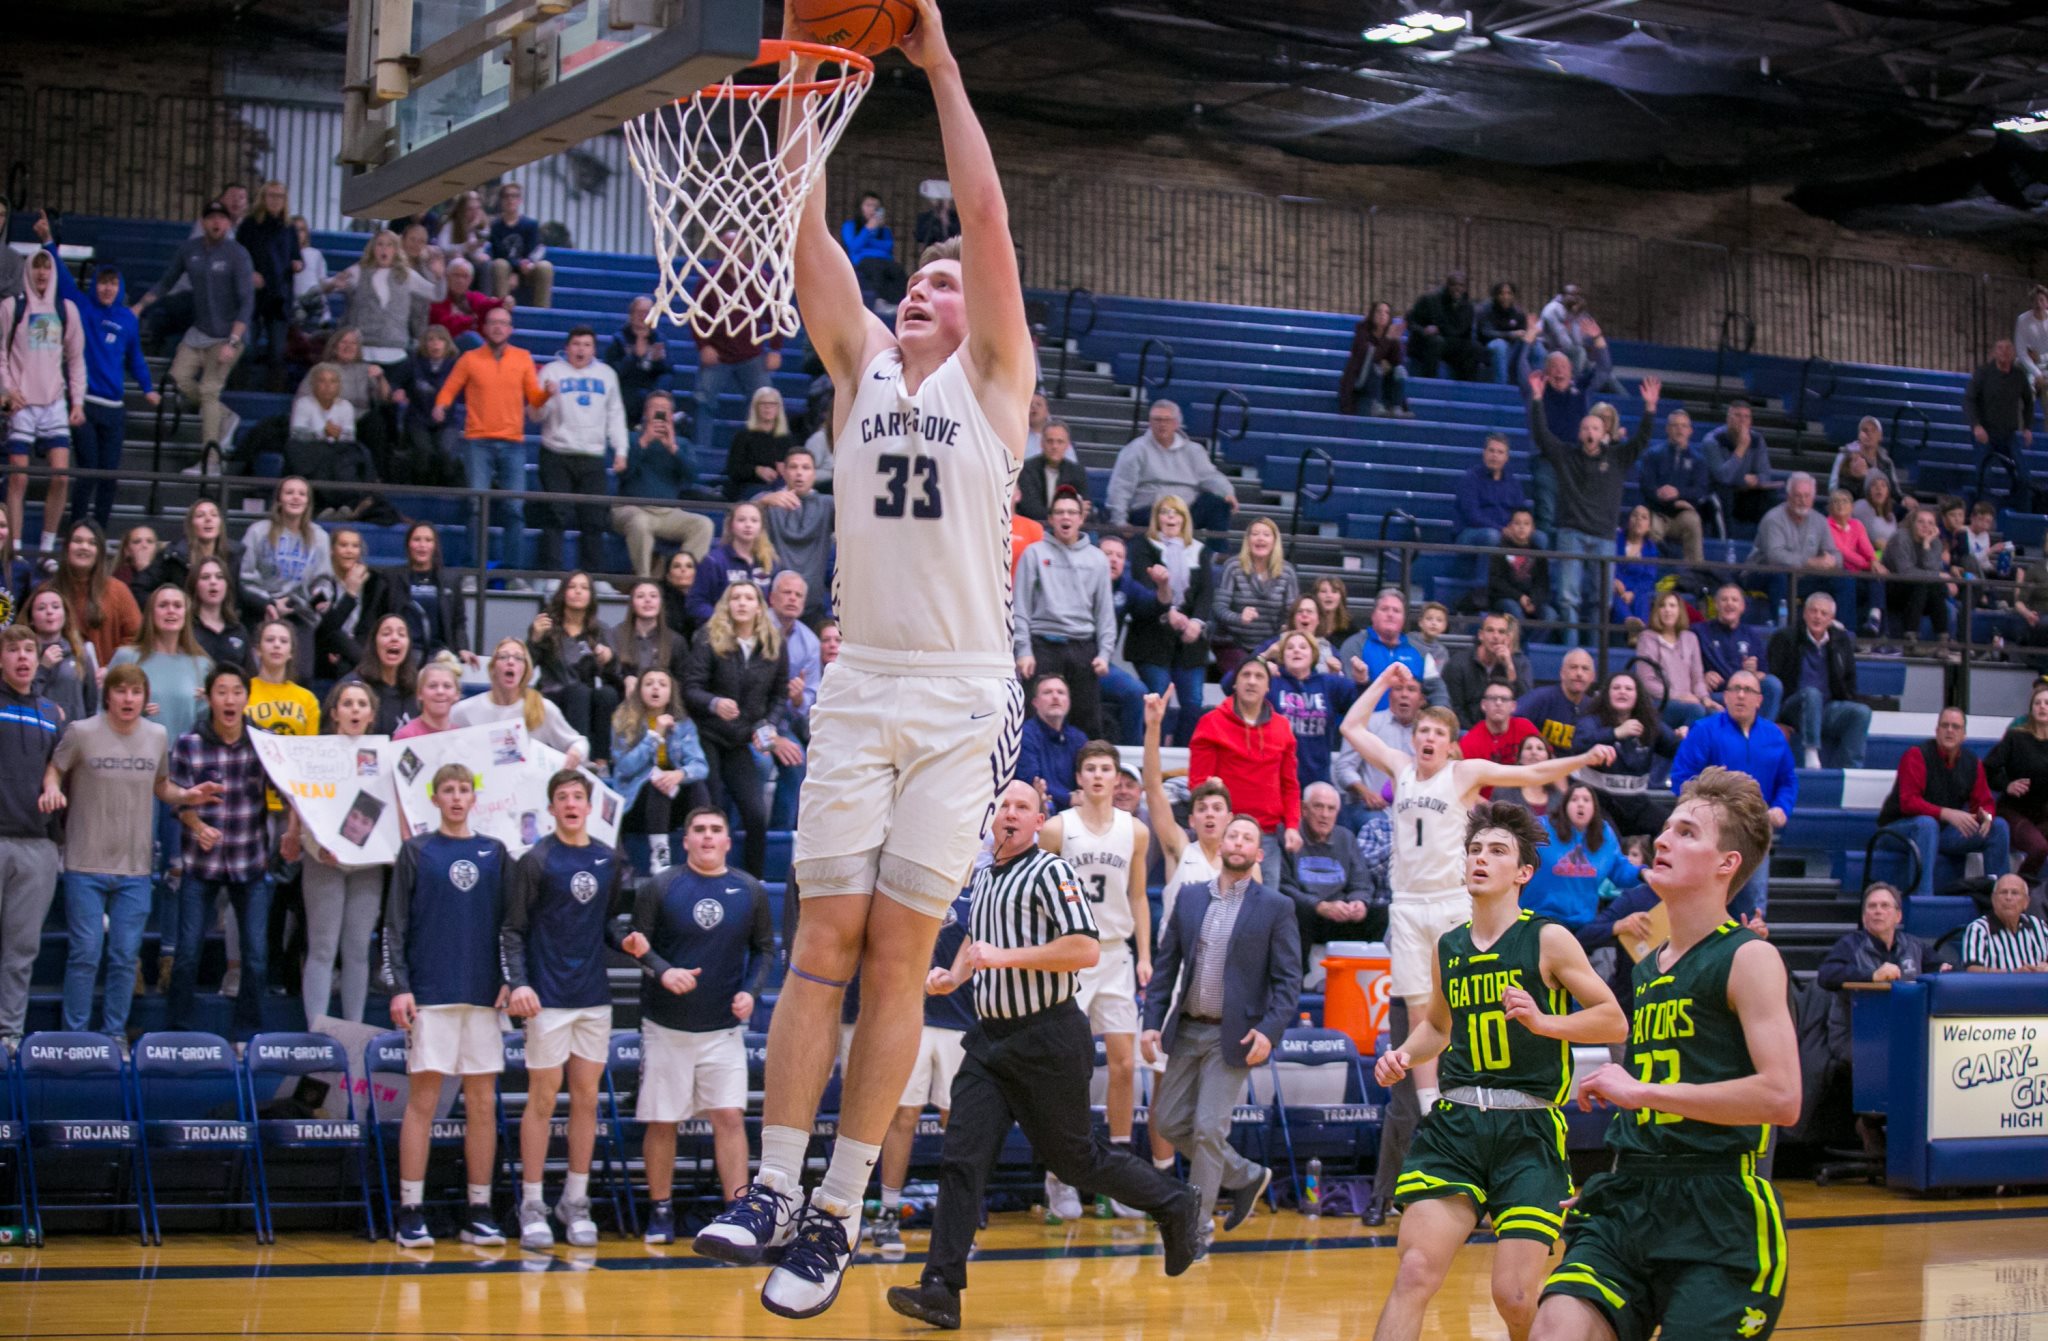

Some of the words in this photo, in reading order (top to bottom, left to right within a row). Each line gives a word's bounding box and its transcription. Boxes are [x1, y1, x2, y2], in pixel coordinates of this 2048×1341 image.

[862, 407, 961, 446] CARY-GOVE
[874, 454, 942, 518] 33
[1416, 818, 1423, 846] 1
[1633, 998, 1695, 1045] ATORS
[1467, 1010, 1511, 1072] 10
[1944, 1025, 2017, 1042] Welcome
[2022, 1026, 2037, 1040] to
[259, 1046, 334, 1060] CARY-GROVE
[1282, 1039, 1346, 1052] CARY-GROVE
[31, 1046, 109, 1061] CARY-GROVE
[146, 1046, 222, 1061] CARY-GROVE
[1952, 1044, 2039, 1090] CARY-
[1323, 1108, 1378, 1121] TROJANS
[2001, 1112, 2043, 1128] HIGH
[63, 1126, 131, 1140] TROJANS
[183, 1126, 248, 1140] TROJANS
[296, 1124, 361, 1139] TROJANS
